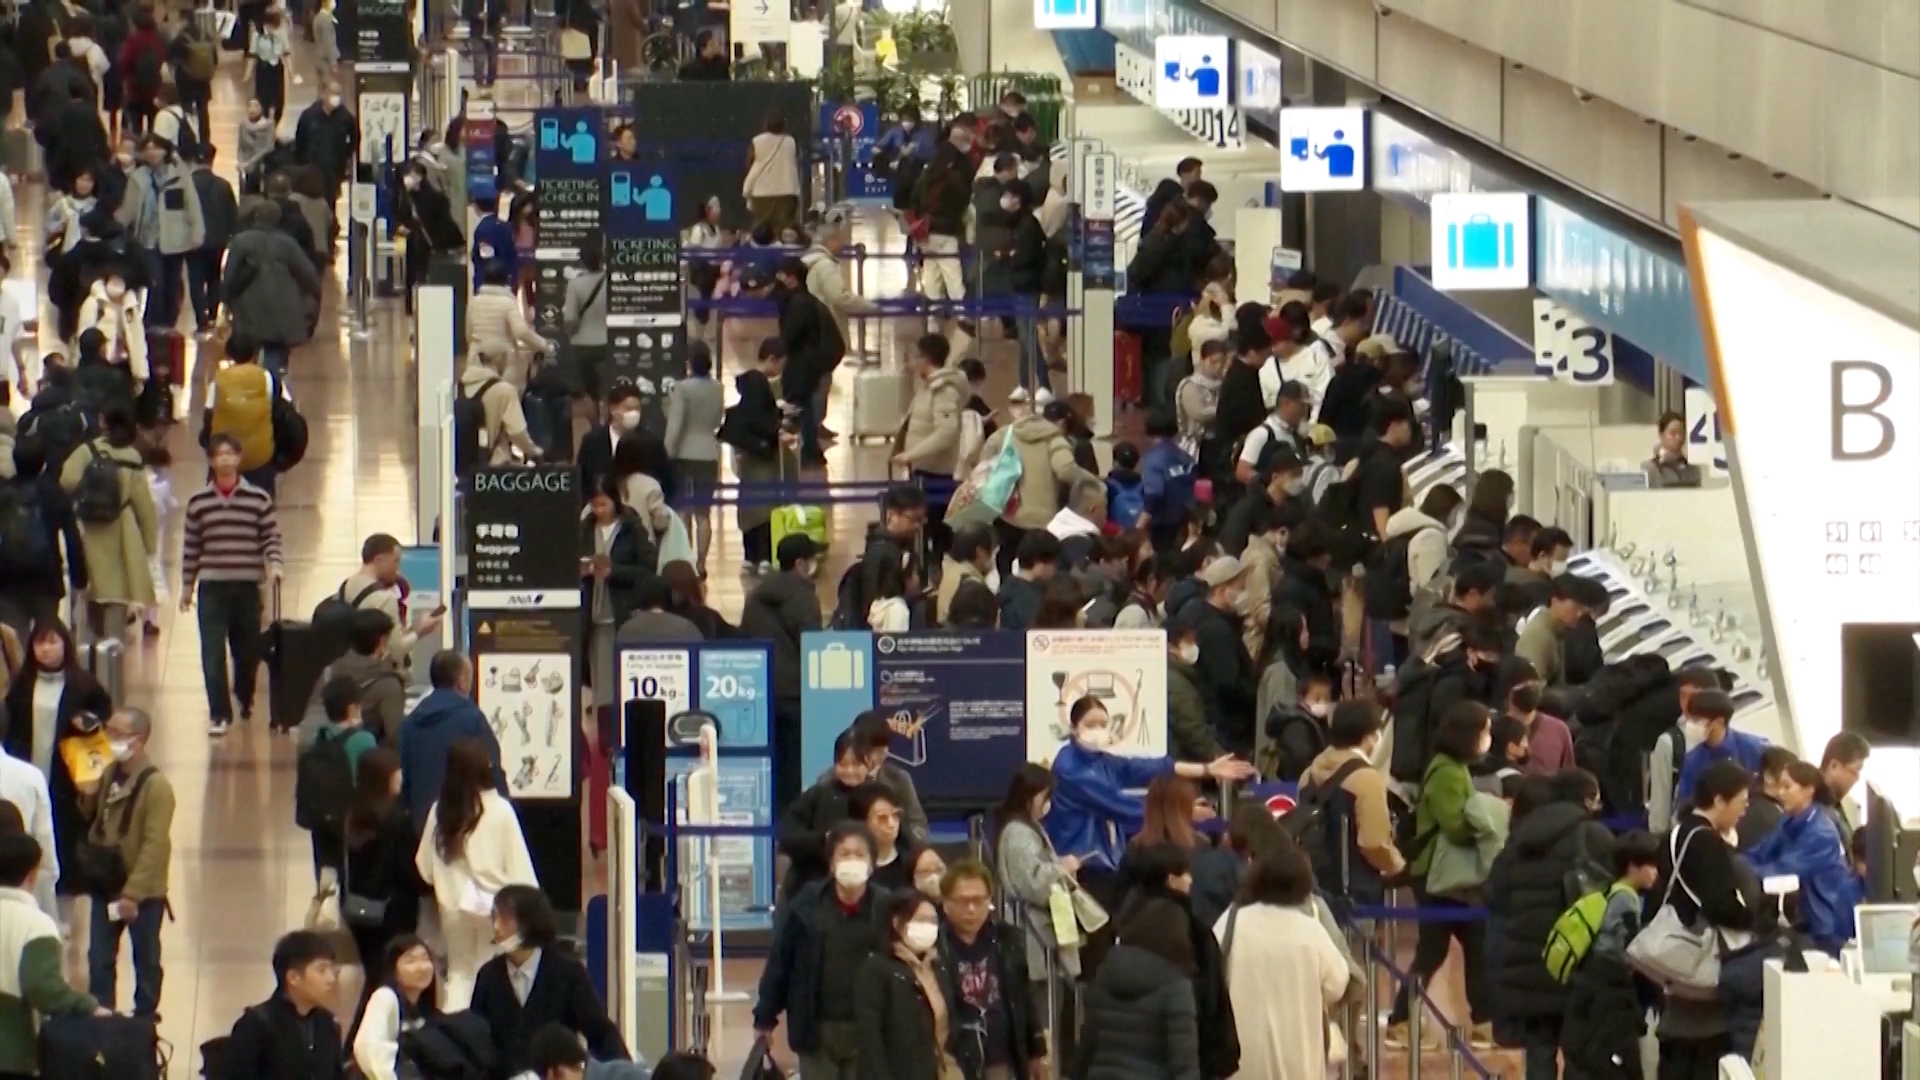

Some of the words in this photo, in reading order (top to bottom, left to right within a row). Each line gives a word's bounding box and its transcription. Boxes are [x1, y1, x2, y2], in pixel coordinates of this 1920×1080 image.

[540, 179, 599, 190] TICKETING
[612, 239, 677, 250] TICKETING
[663, 252, 677, 265] IN
[1571, 327, 1610, 382] 3
[1831, 360, 1896, 461] B
[475, 472, 571, 491] BAGGAGE
[629, 675, 658, 698] 10
[660, 687, 677, 699] kg
[706, 674, 737, 699] 20
[738, 686, 755, 700] kg
